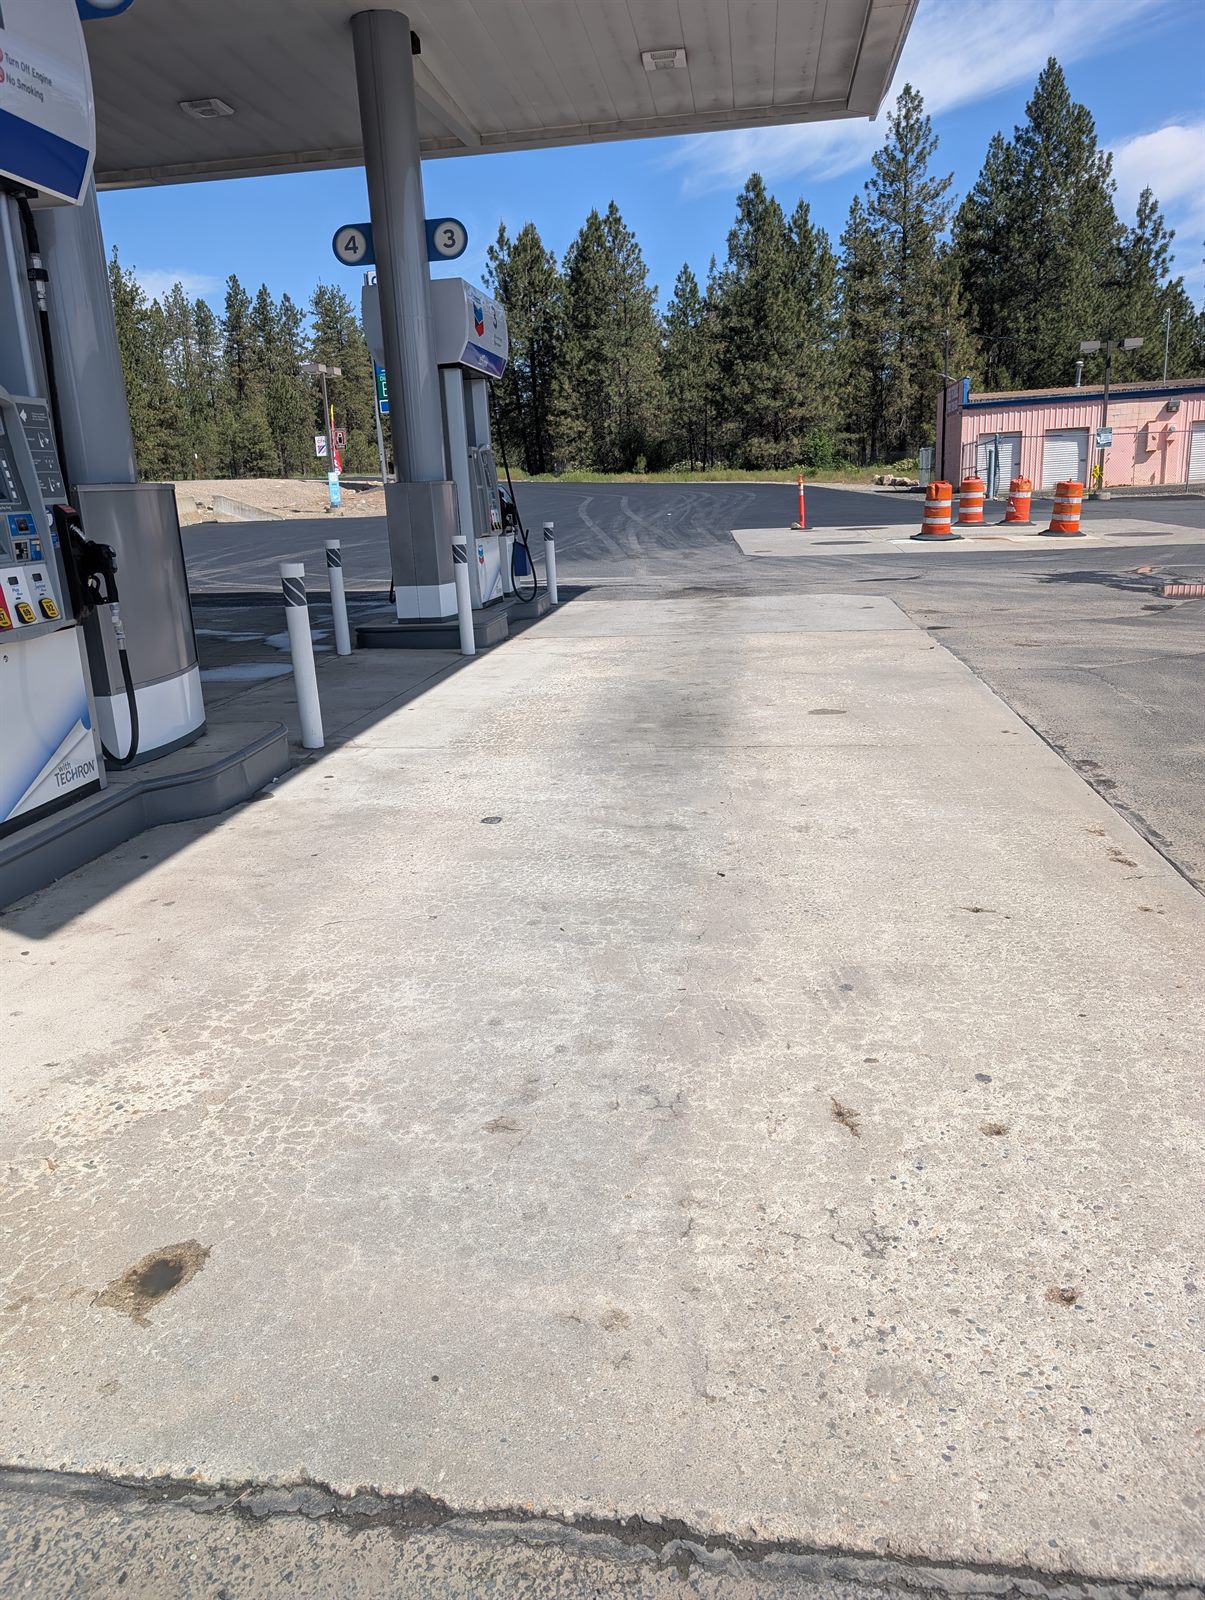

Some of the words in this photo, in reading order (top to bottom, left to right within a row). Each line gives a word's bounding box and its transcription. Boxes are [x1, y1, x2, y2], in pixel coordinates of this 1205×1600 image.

[5, 52, 19, 69] Turn
[21, 62, 30, 75] Off
[32, 67, 52, 87] Engine
[6, 73, 15, 86] No
[17, 79, 44, 103] Smoking
[344, 235, 359, 254] 4
[442, 229, 456, 248] 3
[54, 760, 95, 787] TECHRON
[58, 761, 71, 772] with
